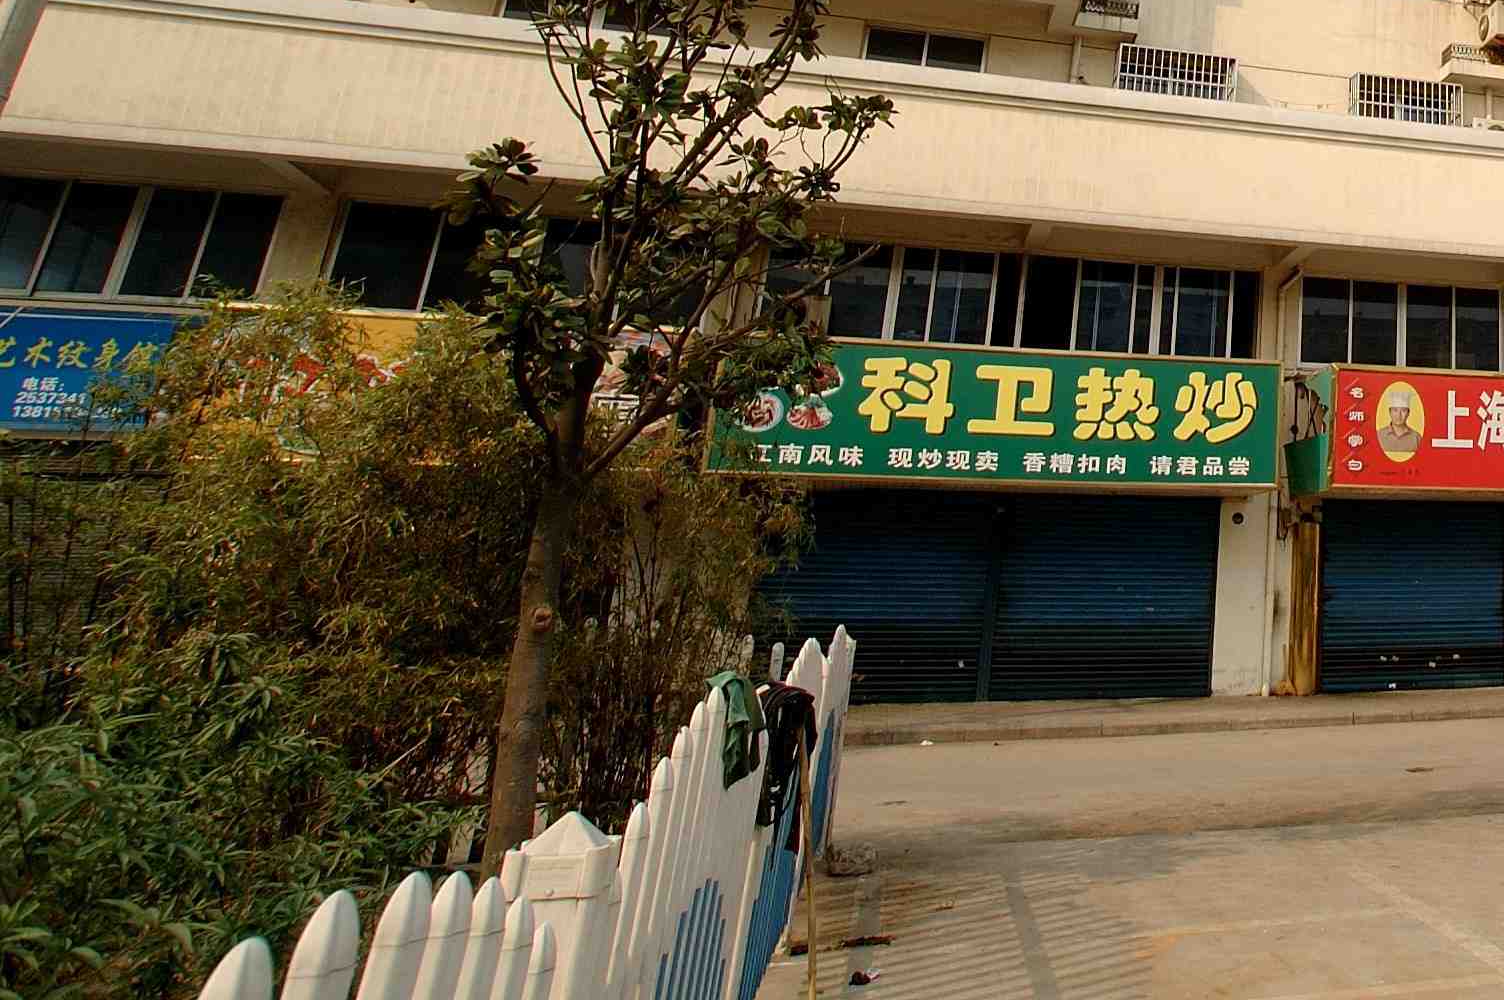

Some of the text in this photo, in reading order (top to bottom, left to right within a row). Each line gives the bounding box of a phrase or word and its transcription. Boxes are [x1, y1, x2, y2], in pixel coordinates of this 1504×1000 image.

[857, 356, 1258, 444] 科卫热炒
[887, 446, 999, 473] 现炒现卖
[1149, 454, 1250, 477] 请君品尝
